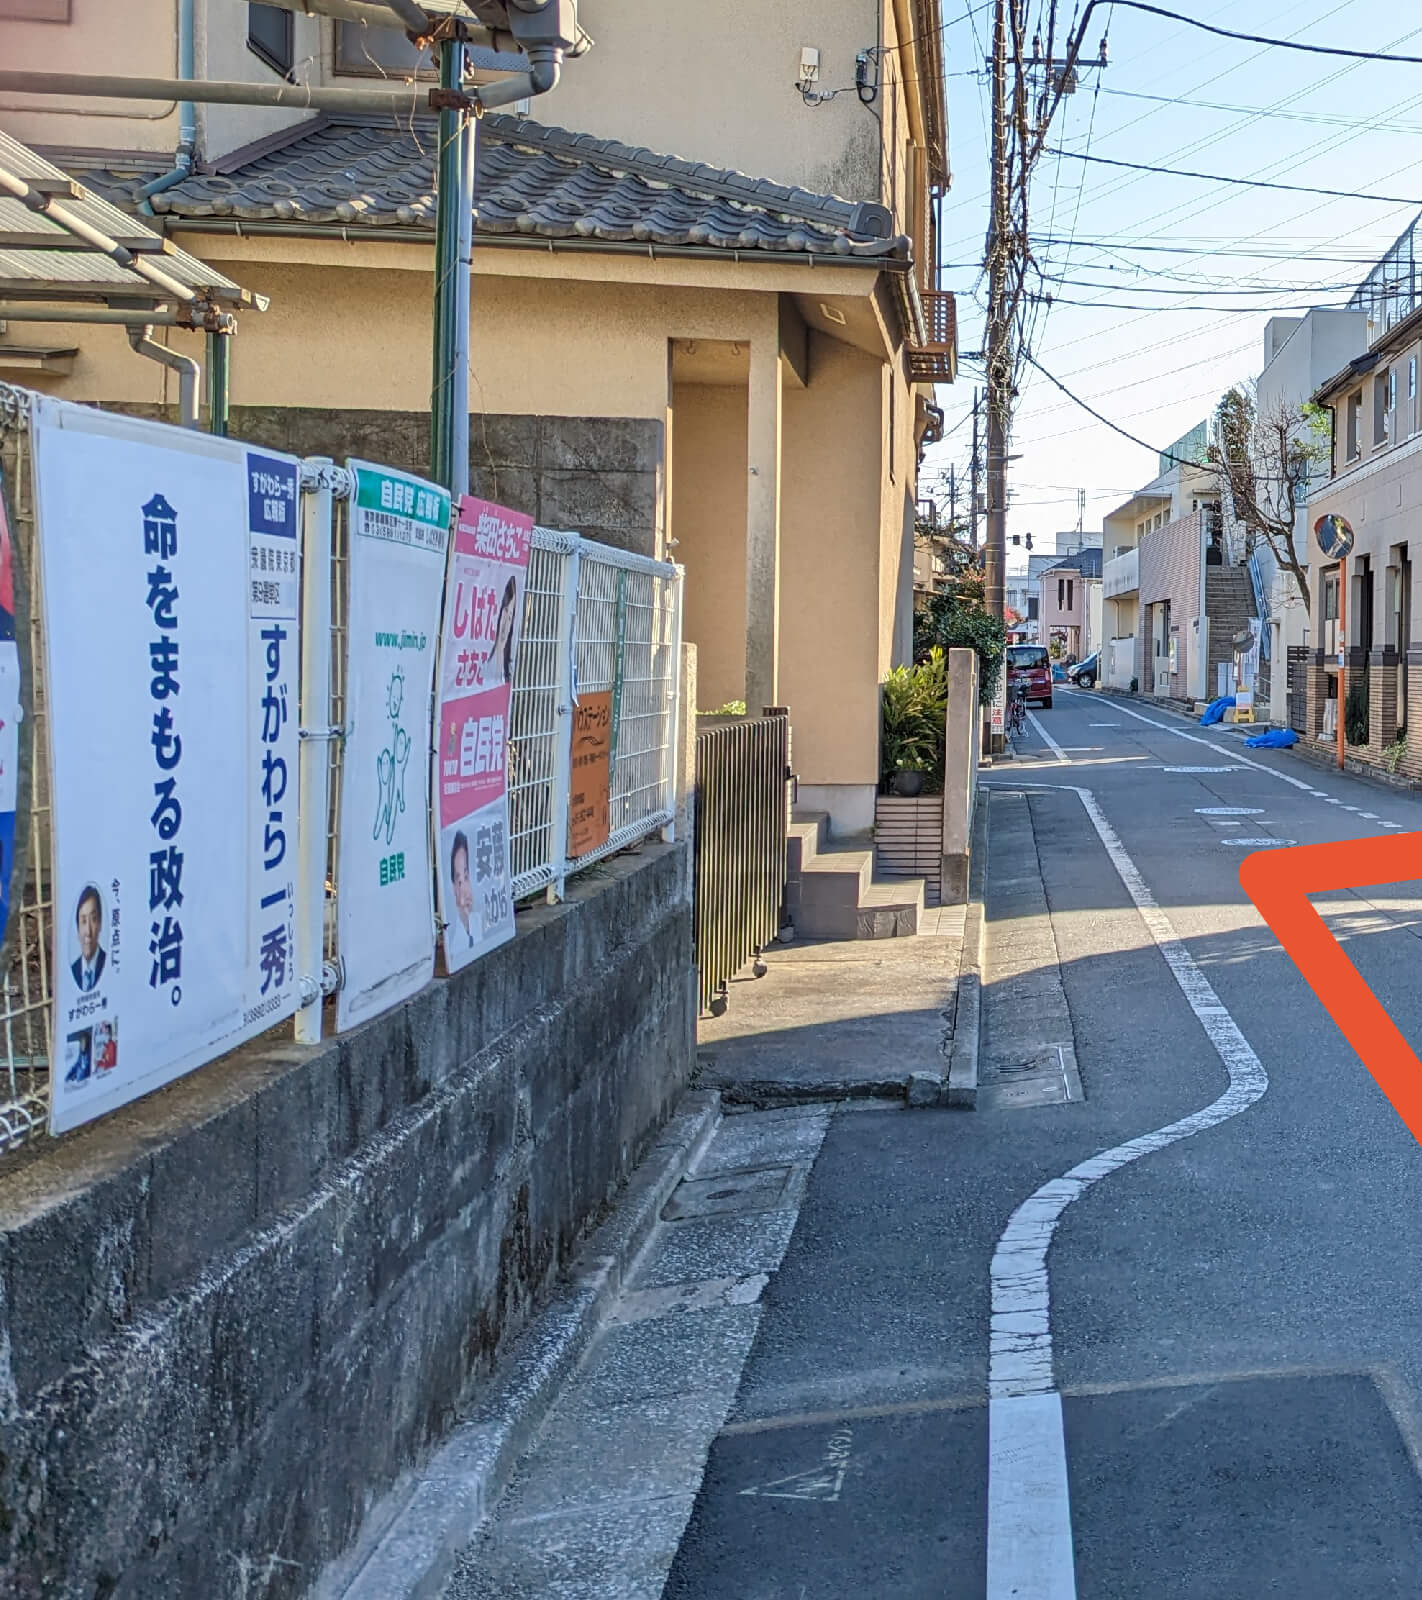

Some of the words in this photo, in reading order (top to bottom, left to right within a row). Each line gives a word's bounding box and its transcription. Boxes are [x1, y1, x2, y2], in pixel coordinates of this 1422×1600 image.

[453, 582, 497, 640] しばた
[375, 631, 427, 650] www.jimin.jp
[455, 648, 488, 687] さちこ
[141, 493, 184, 1007] 命をまもる政治。
[460, 716, 504, 777] 自民党
[260, 623, 288, 995] すがわら一秀
[379, 853, 406, 887] 自民党
